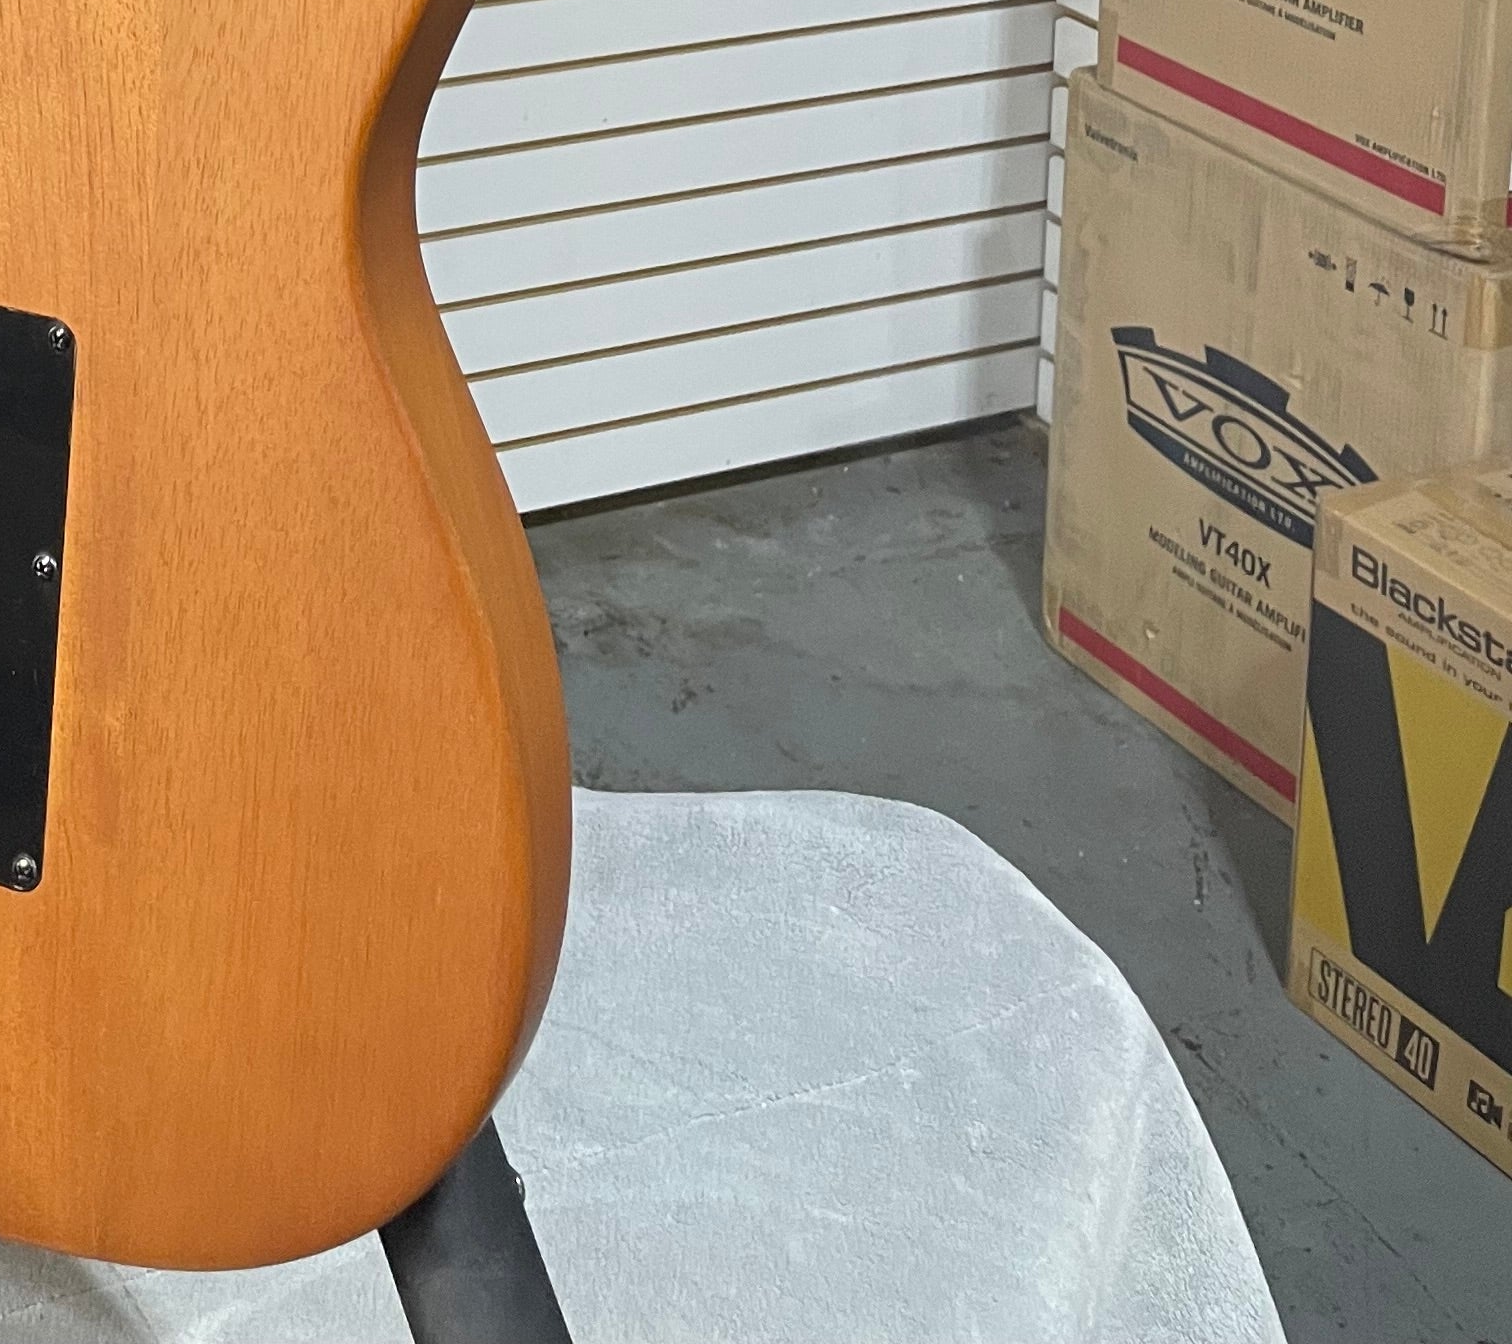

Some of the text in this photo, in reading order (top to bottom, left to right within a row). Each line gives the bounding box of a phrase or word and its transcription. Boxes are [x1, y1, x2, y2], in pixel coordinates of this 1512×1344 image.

[1143, 366, 1344, 506] VOX
[1199, 517, 1271, 590] VT40X
[1350, 602, 1504, 703] the sound in your
[1398, 612, 1502, 682] AMPLIFICATION
[1318, 959, 1434, 1081] STEREO 40
